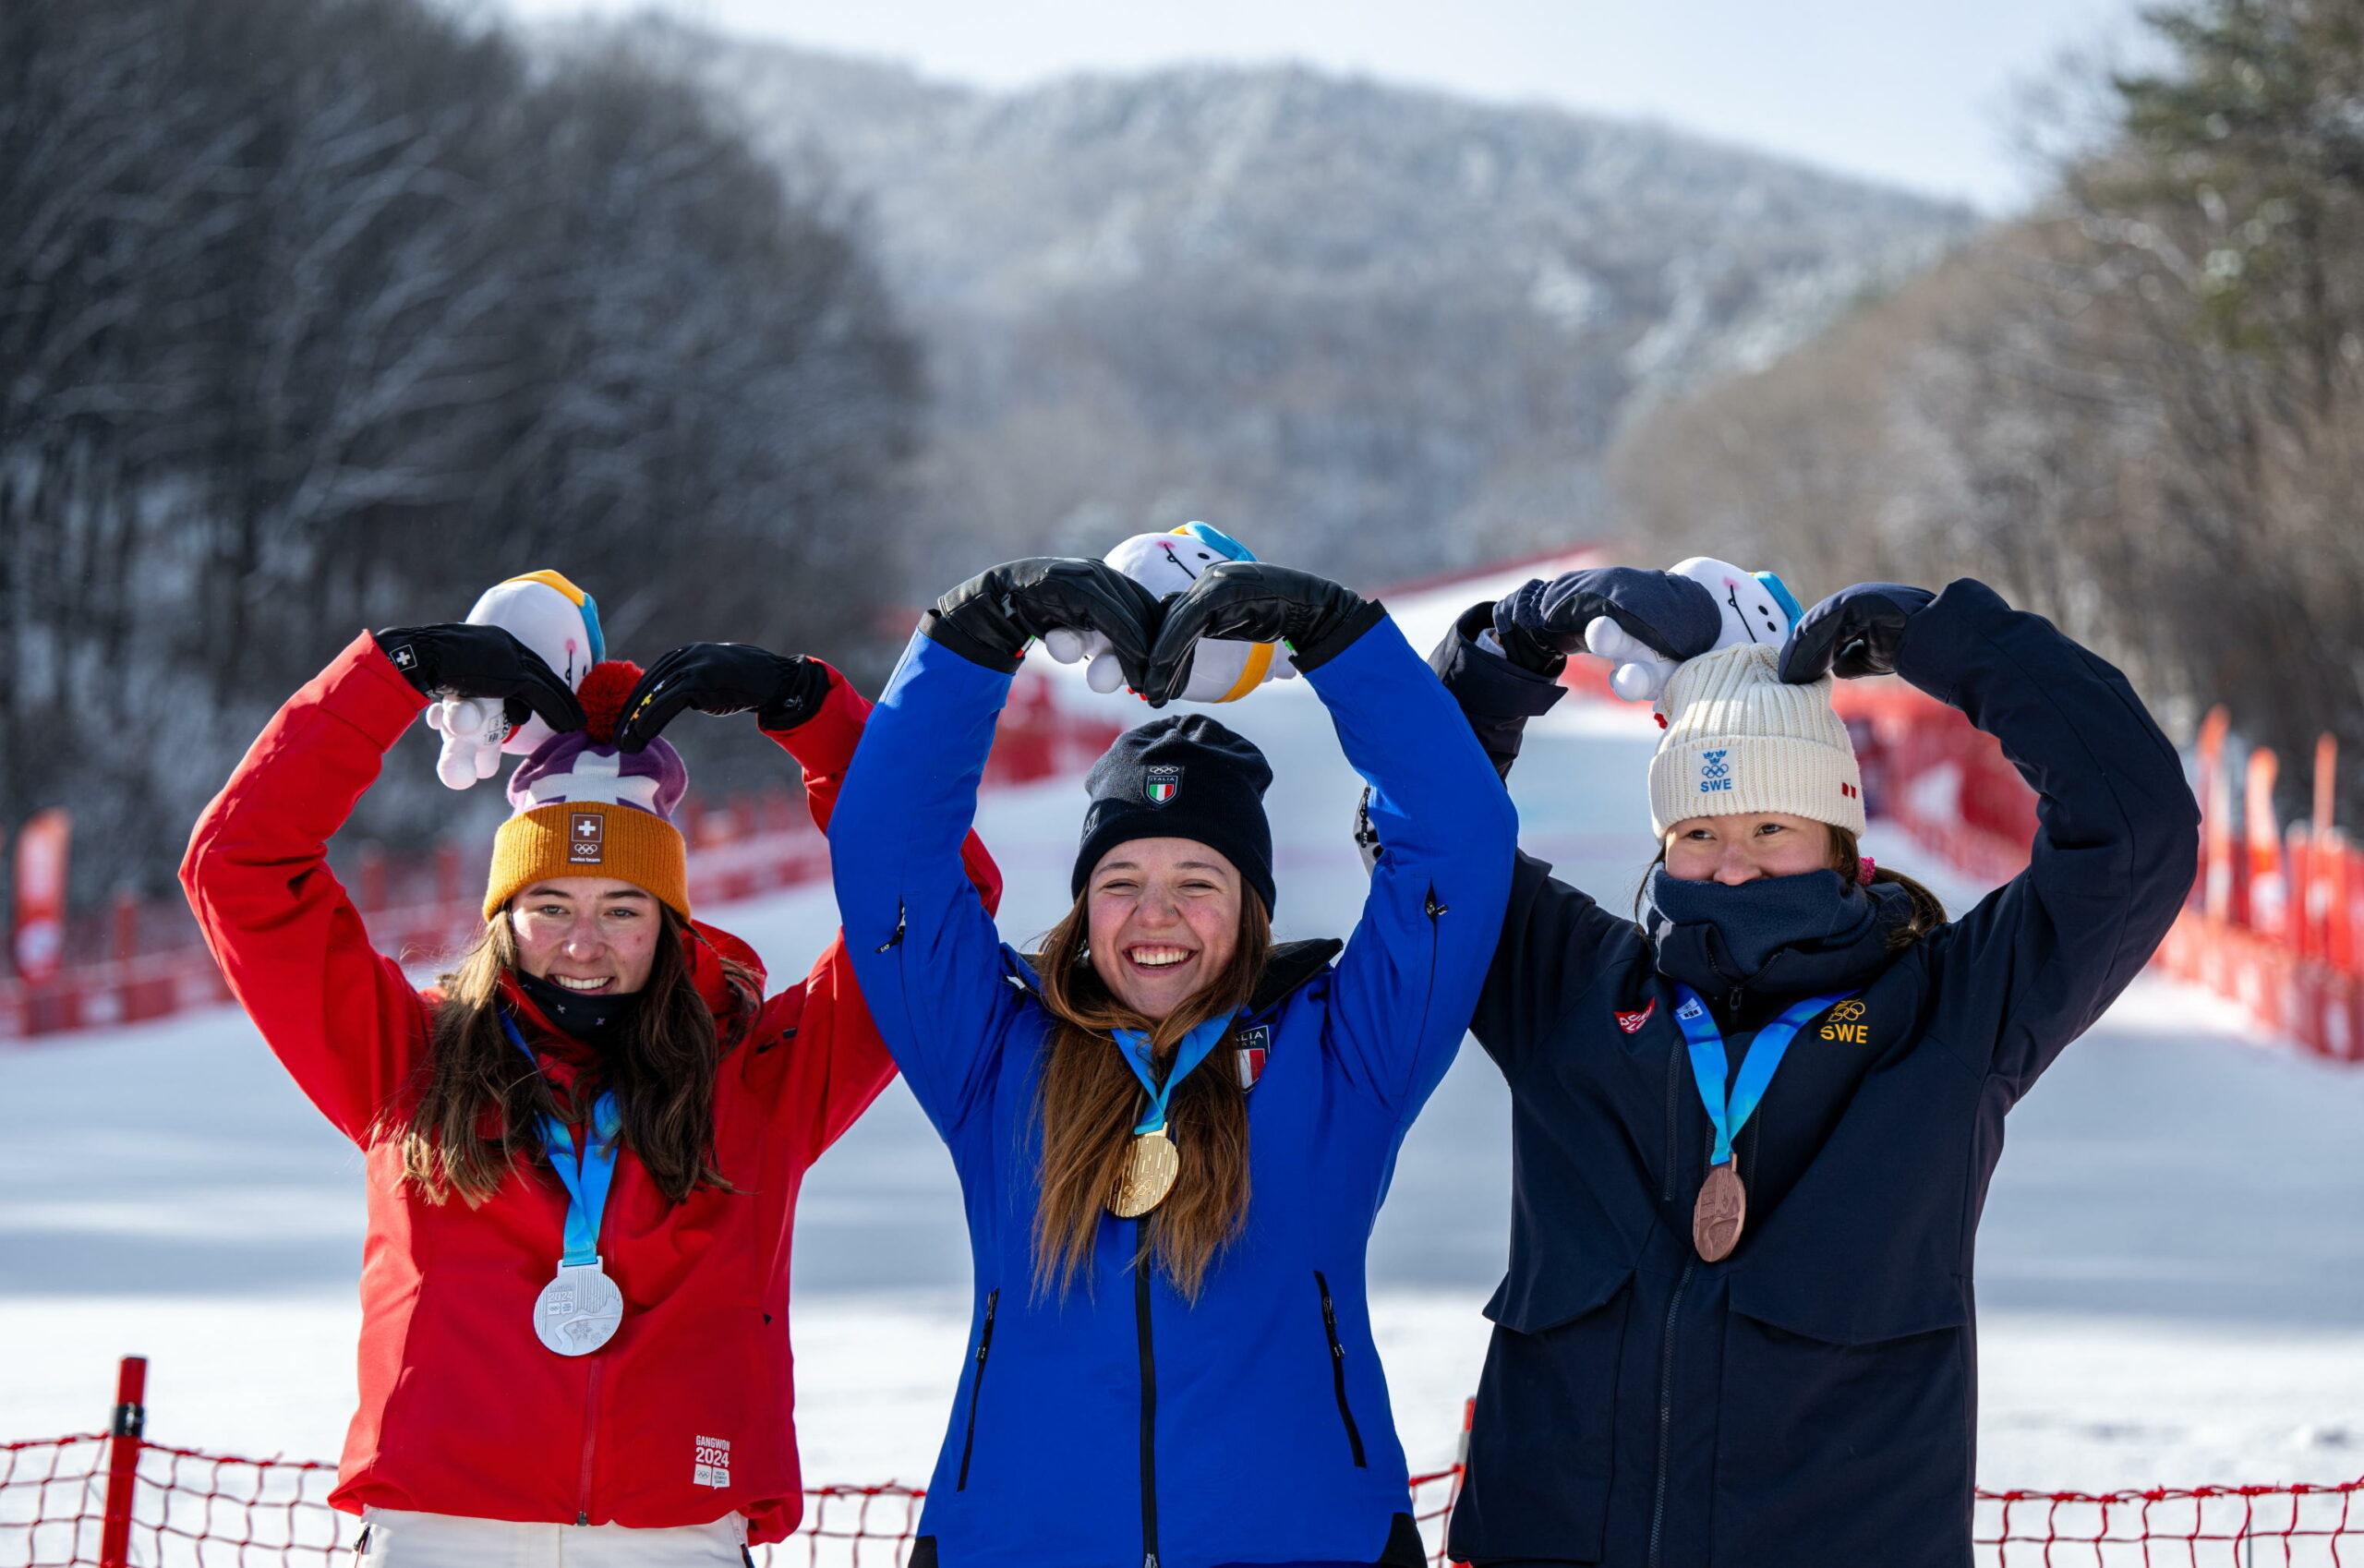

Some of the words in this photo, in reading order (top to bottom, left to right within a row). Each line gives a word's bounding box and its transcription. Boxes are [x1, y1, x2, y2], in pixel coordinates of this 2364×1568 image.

[1700, 778, 1732, 793] SWE
[1820, 1023, 1869, 1043] SWE
[695, 1435, 730, 1452] GANGWON
[695, 1446, 730, 1468] 2024
